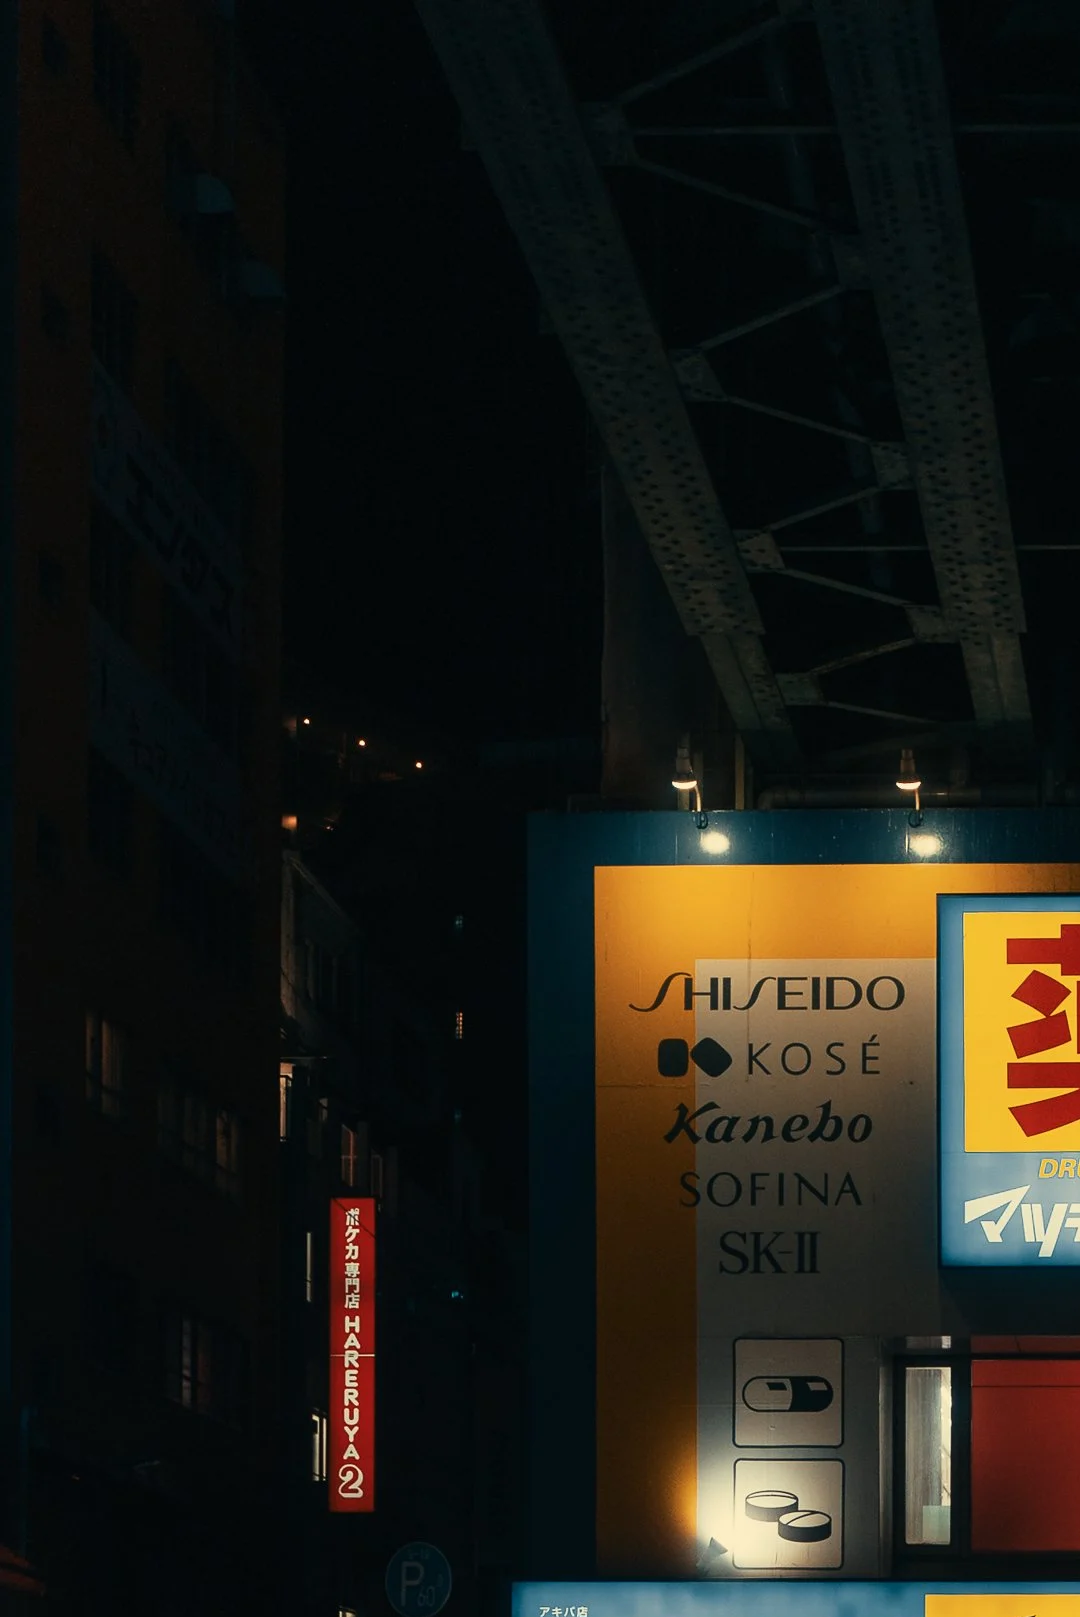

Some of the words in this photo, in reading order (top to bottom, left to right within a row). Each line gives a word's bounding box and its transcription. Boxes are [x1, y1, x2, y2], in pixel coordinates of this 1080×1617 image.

[629, 972, 906, 1013] SHISEIDO
[747, 1034, 882, 1076] KOSÉ
[663, 1100, 873, 1145] Kanebo
[679, 1171, 862, 1209] SOFINA
[344, 1208, 360, 1310] ポケカ専門店
[718, 1230, 820, 1276] SK-II
[343, 1315, 361, 1460] HARERUYA
[338, 1464, 364, 1499] 2
[401, 1561, 424, 1607] P
